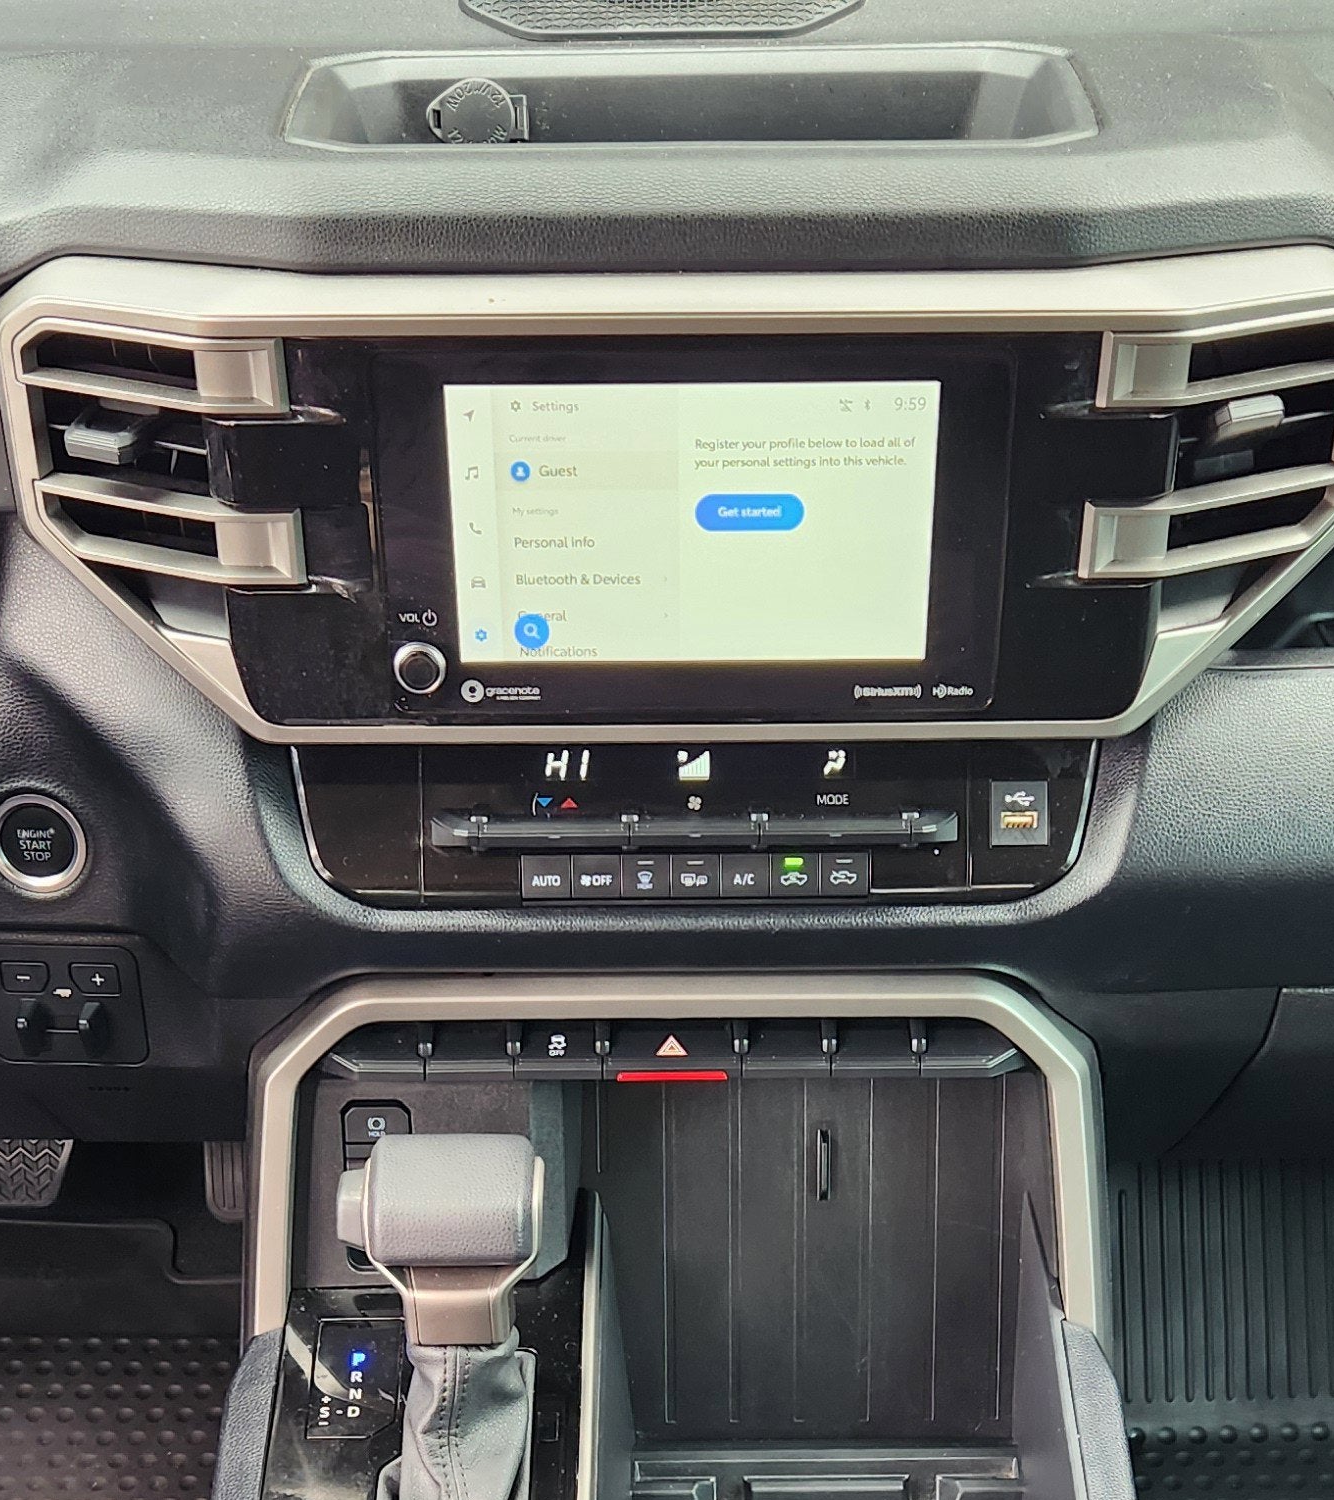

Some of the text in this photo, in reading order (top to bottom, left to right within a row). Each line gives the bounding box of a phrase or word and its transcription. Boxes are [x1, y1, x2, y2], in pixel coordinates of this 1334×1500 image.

[532, 401, 580, 414] Settings
[894, 397, 927, 411] 9:59
[509, 434, 540, 443] Current
[695, 436, 916, 452] Register your profile below to load all of
[694, 454, 907, 471] your personal settings into this vehicle.
[539, 465, 578, 477] Guest
[512, 507, 559, 517] My settings
[717, 505, 782, 518] Get started
[513, 536, 568, 549] Personal
[516, 573, 641, 586] Bluetooth & Devices
[398, 612, 420, 623] VOL
[519, 645, 598, 657] Notifications
[485, 686, 541, 697] gracenote
[947, 686, 974, 696] Radio
[816, 794, 850, 806] MODE
[17, 829, 53, 839] ENGINE
[19, 840, 52, 851] START
[23, 851, 52, 861] STOP
[532, 875, 561, 887] AUTO
[592, 874, 613, 886] OFF
[733, 873, 755, 885] A/C
[352, 1352, 366, 1367] P
[350, 1371, 363, 1383] R
[349, 1388, 363, 1400] N
[319, 1406, 331, 1419] S
[347, 1406, 361, 1418] D
